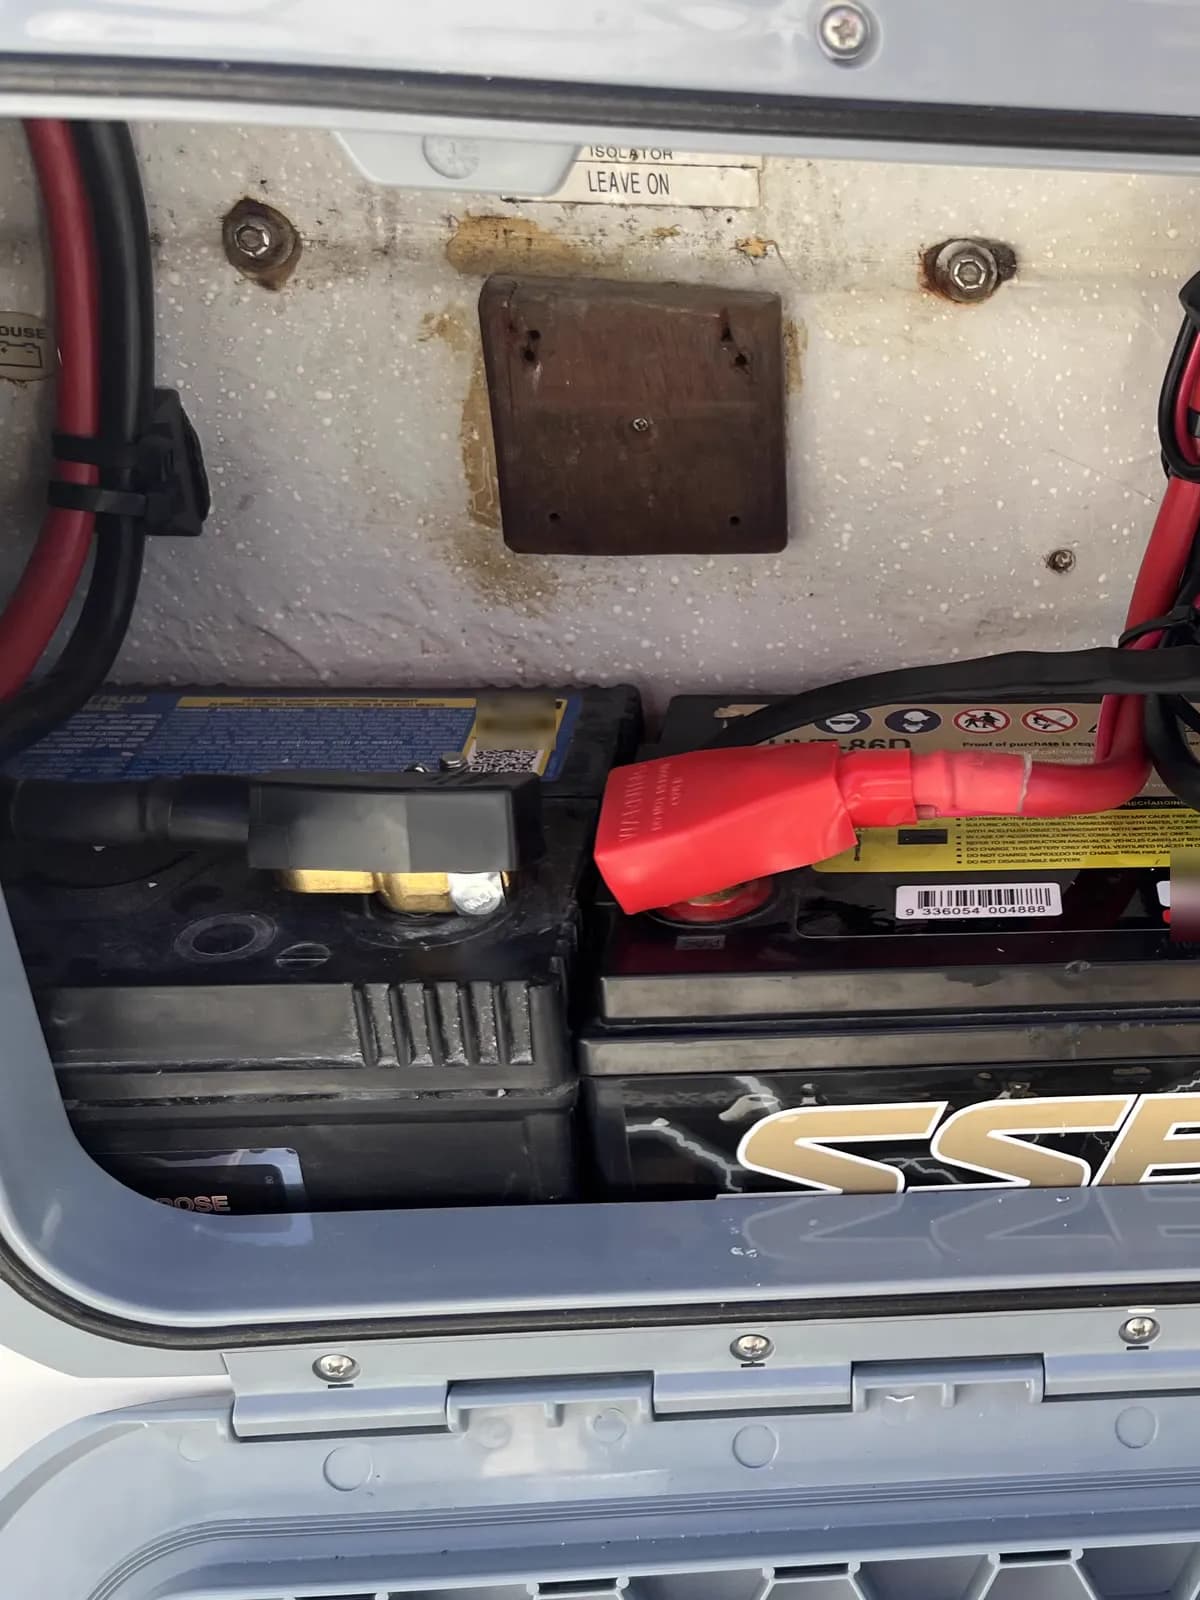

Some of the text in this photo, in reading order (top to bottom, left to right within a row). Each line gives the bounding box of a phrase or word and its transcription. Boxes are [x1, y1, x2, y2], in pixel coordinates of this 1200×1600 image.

[589, 145, 673, 161] ISOLATOR
[588, 170, 670, 195] LEAVE ON
[0, 326, 48, 340] OUSE
[905, 905, 1046, 916] 9 336054 004888
